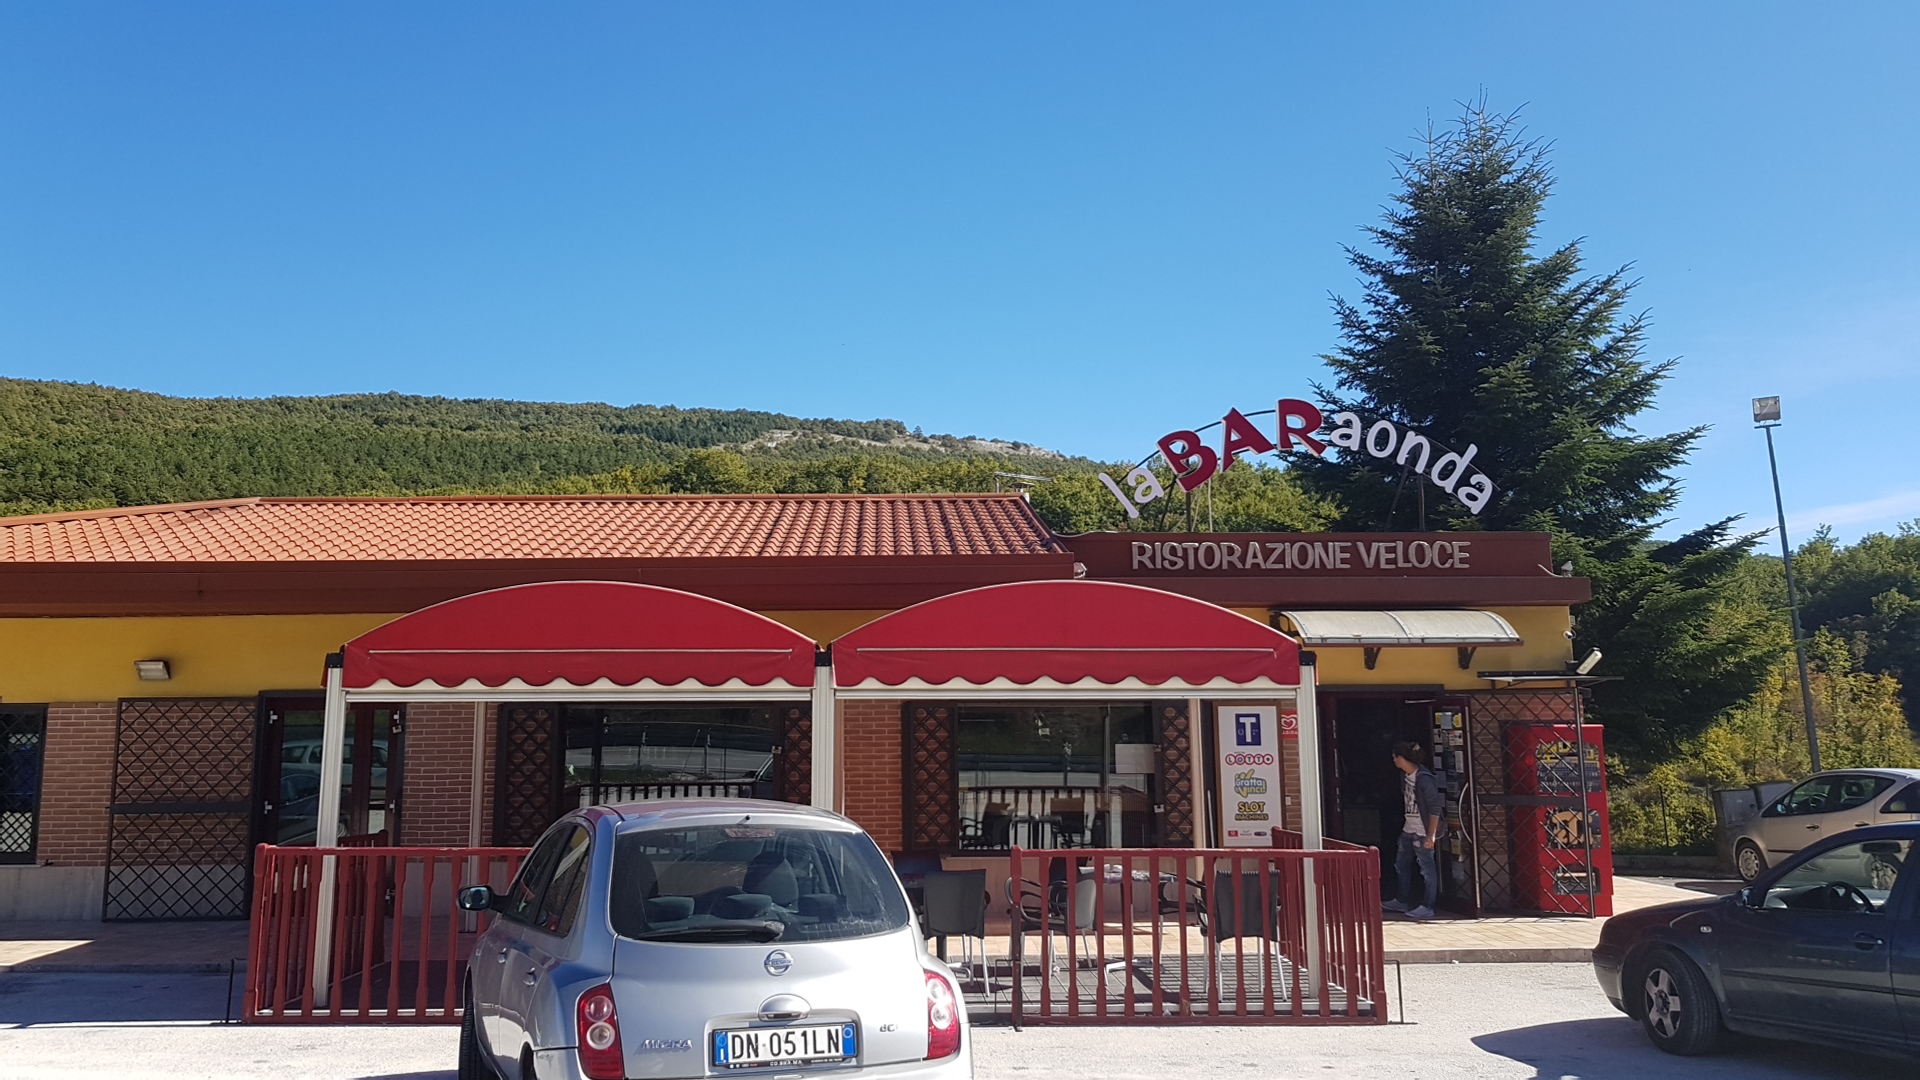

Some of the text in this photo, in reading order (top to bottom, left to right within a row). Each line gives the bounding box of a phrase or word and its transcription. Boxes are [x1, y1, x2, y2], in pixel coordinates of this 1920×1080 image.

[1098, 466, 1164, 519] la
[1131, 540, 1471, 571] RISTORAZIONE VELOCE
[1239, 716, 1257, 743] T
[1235, 812, 1268, 821] MACHINES
[1238, 802, 1265, 813] SLOT
[642, 1039, 693, 1050] MICRA
[731, 1028, 840, 1060] DN 051LN
